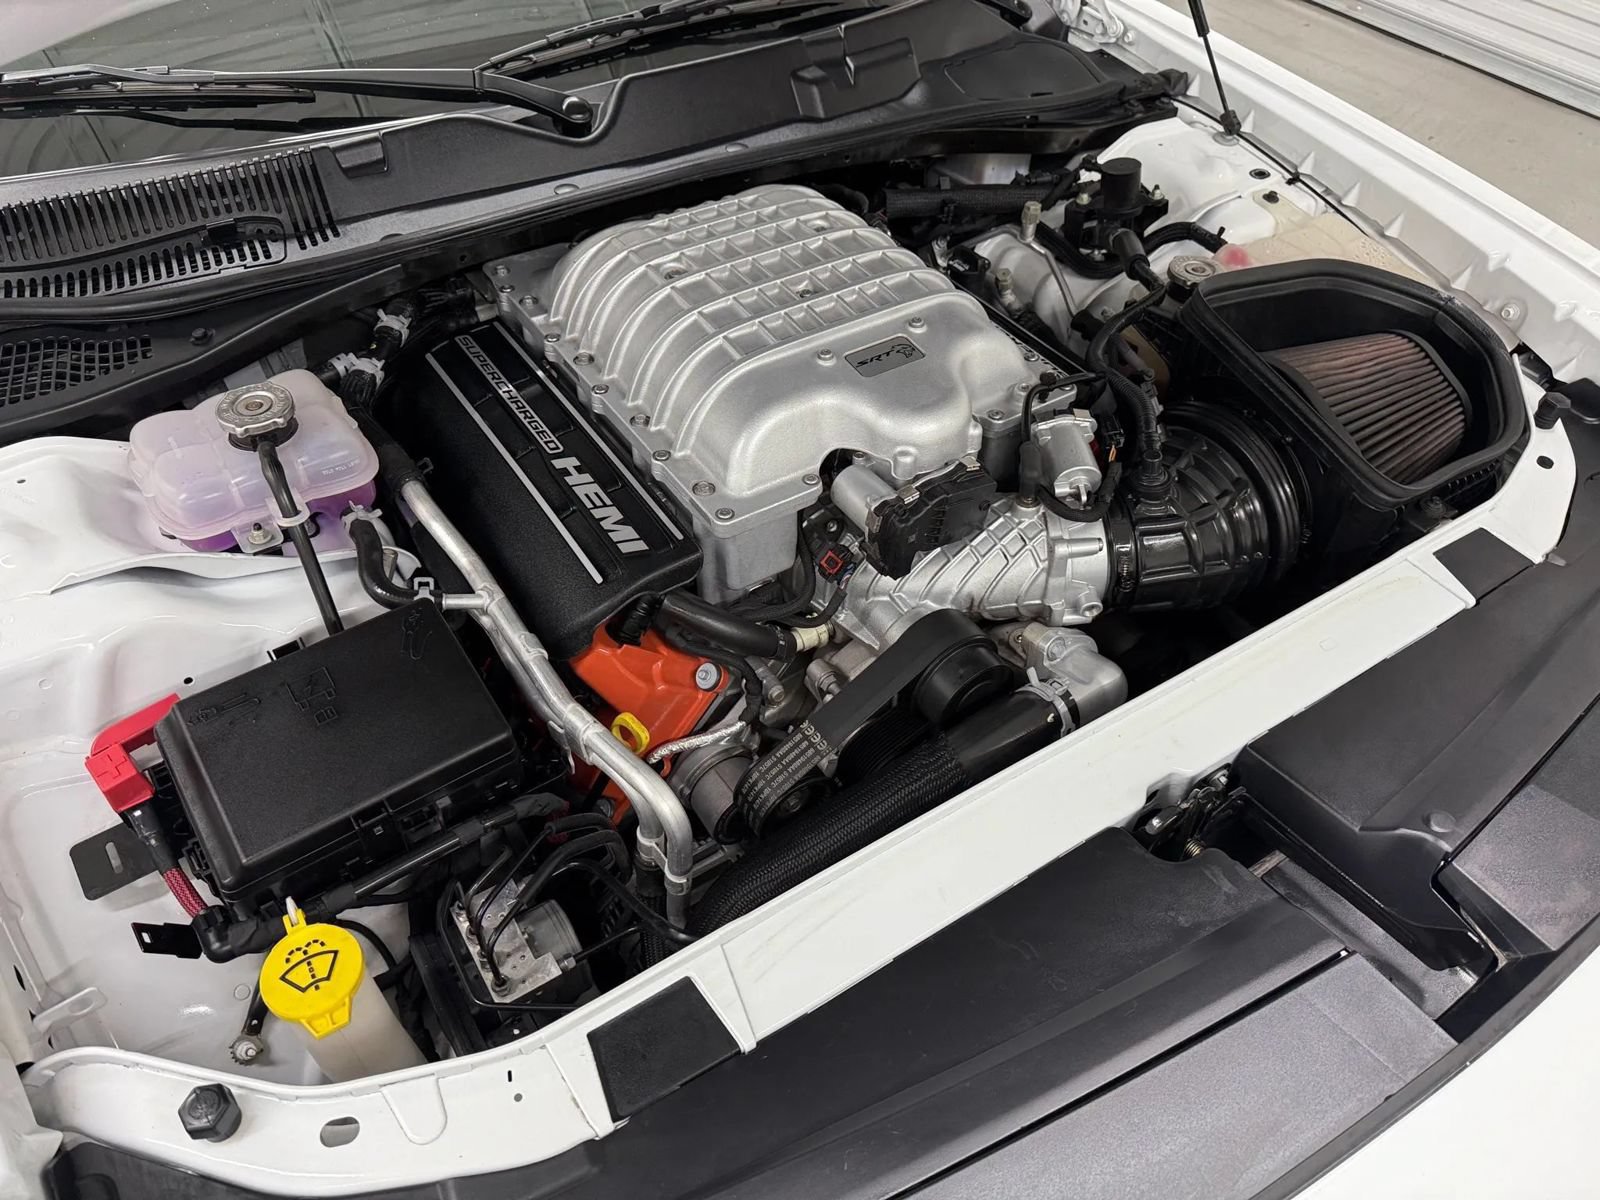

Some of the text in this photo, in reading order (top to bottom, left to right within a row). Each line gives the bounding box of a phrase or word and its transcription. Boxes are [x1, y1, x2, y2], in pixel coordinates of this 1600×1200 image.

[856, 348, 895, 367] SRT
[458, 337, 649, 554] SUPERCHARGED HEMI
